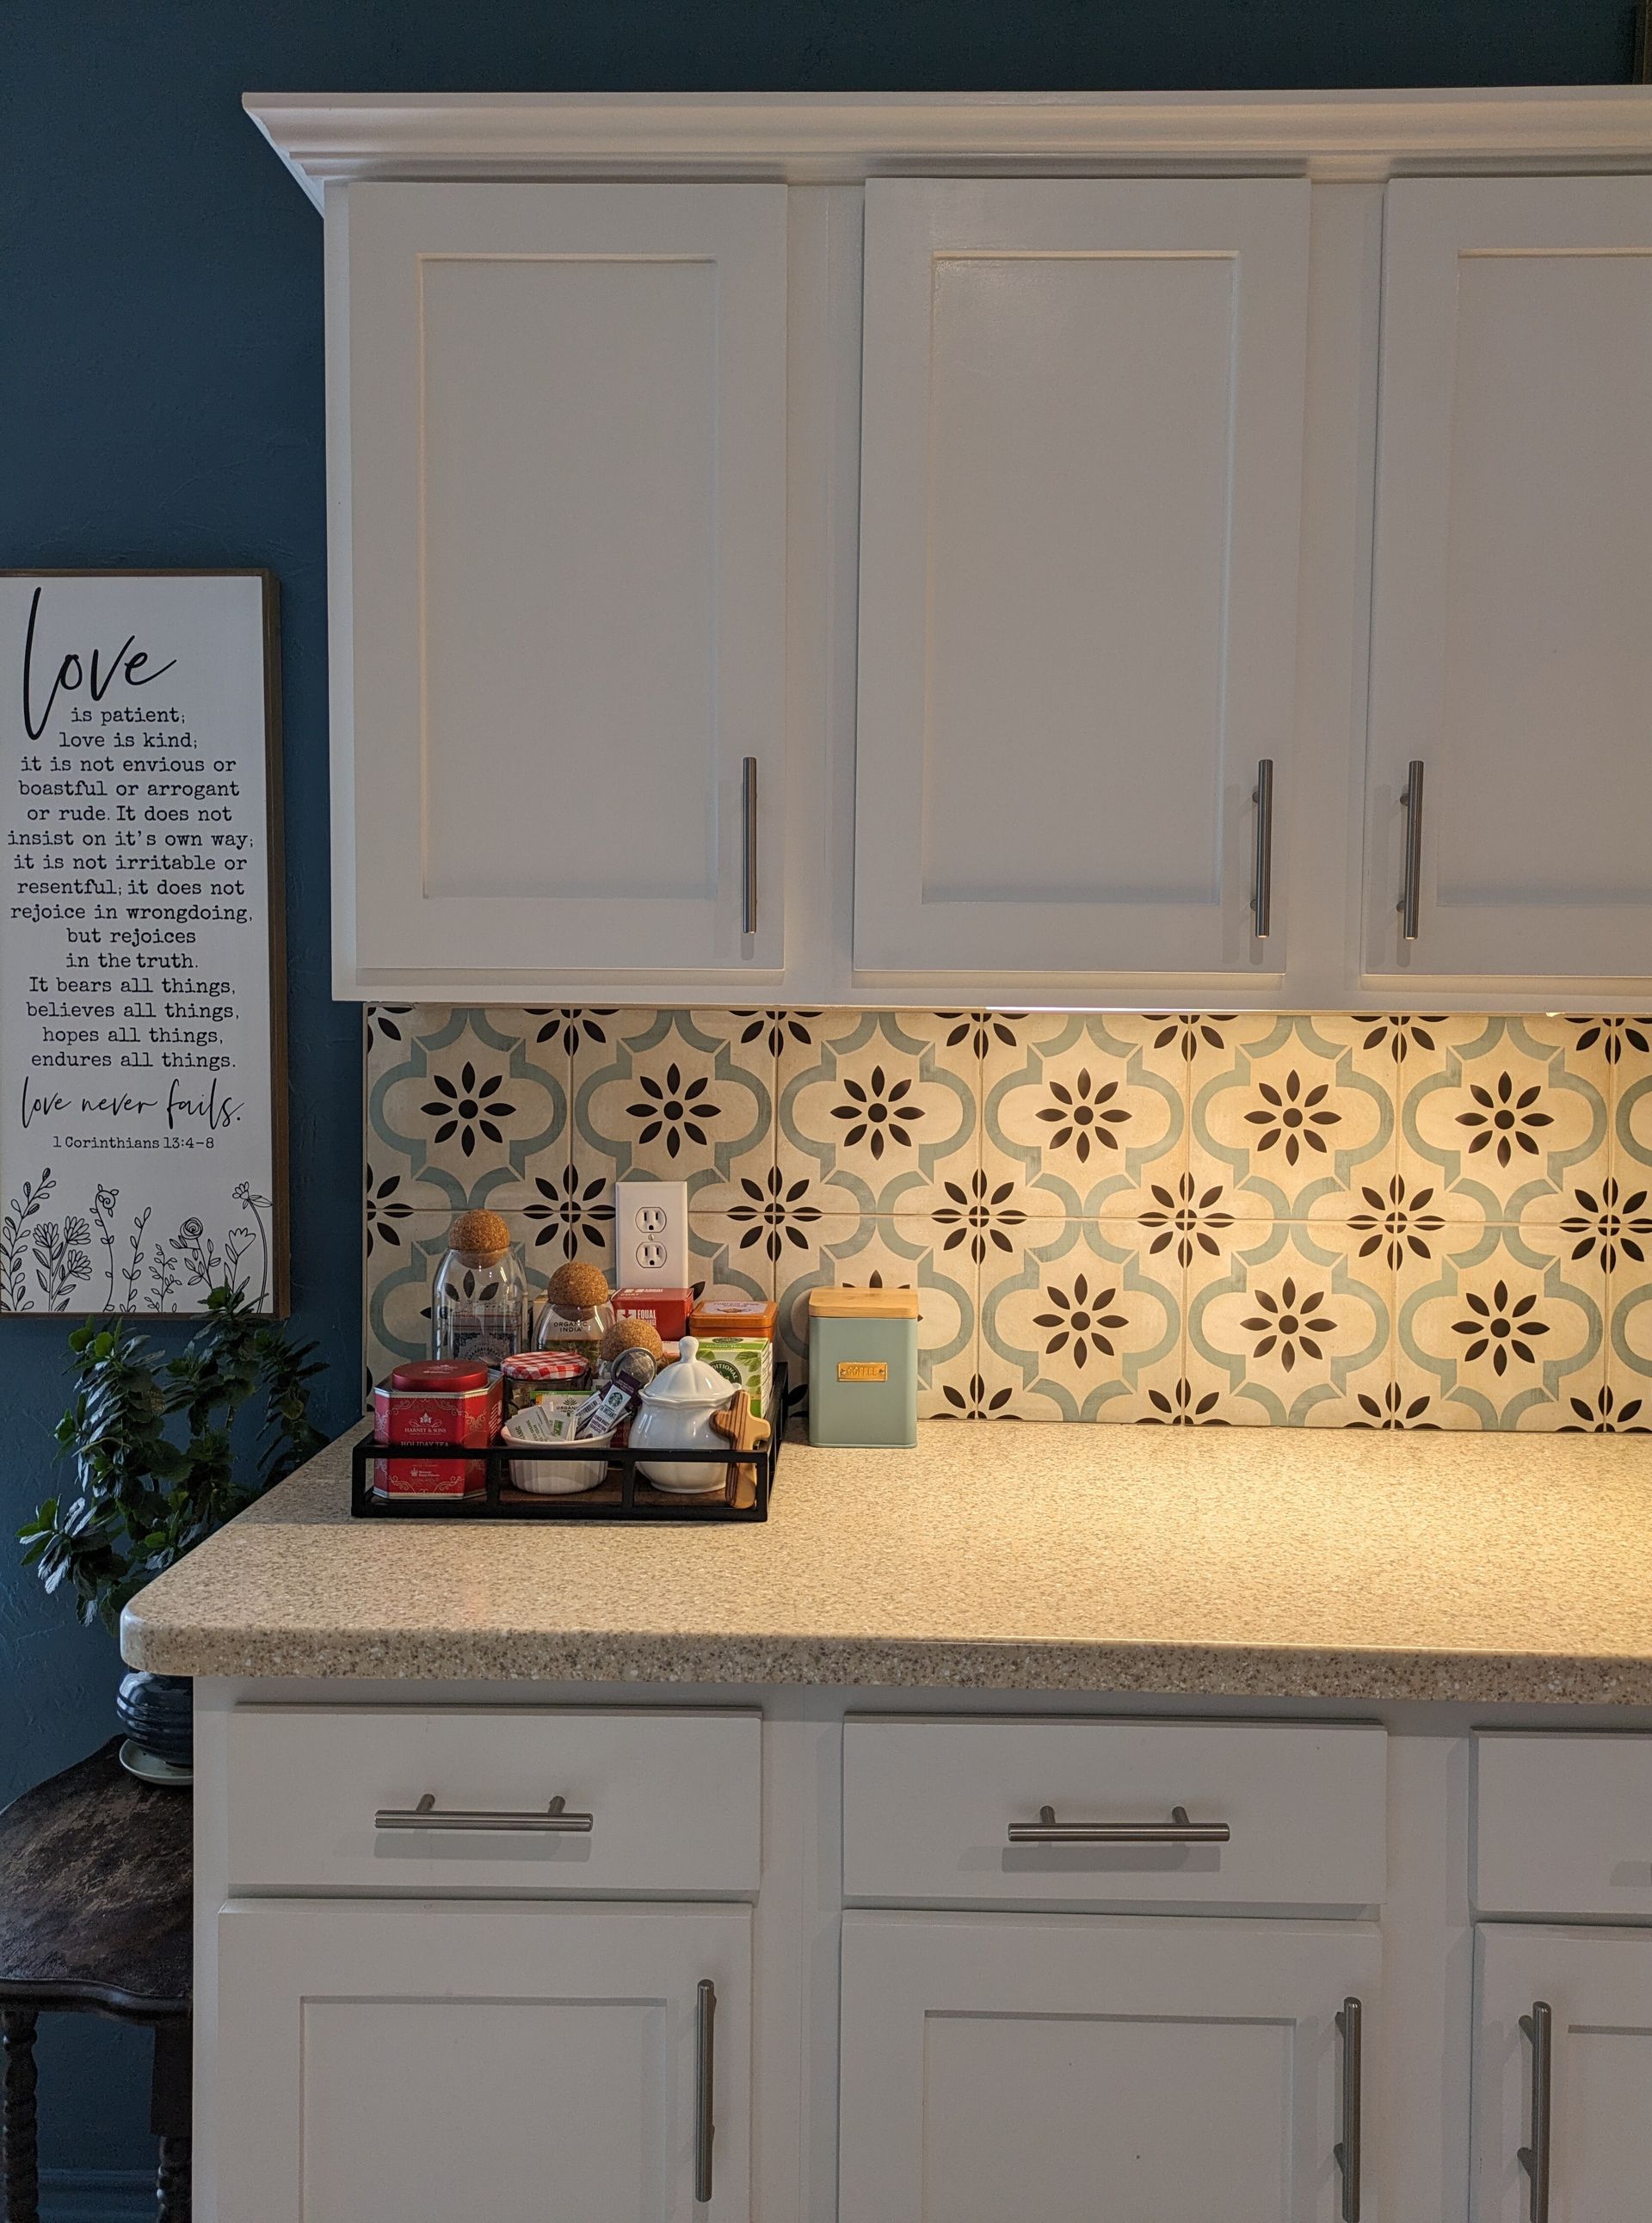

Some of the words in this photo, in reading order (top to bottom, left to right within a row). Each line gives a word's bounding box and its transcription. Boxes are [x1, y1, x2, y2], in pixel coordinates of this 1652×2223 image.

[71, 706, 93, 723] is
[100, 706, 185, 727] patient;
[59, 731, 105, 748] love
[113, 731, 135, 748] is
[142, 731, 197, 749] kind;
[21, 755, 42, 772] it
[50, 755, 71, 772] is
[79, 755, 114, 773] not
[122, 756, 205, 773] envious
[213, 760, 237, 773] or
[17, 779, 108, 797] boastful
[115, 784, 139, 797] or
[147, 780, 240, 801] arrogant
[27, 809, 51, 821] or
[58, 805, 110, 822] rude.
[116, 804, 136, 822] It
[144, 805, 189, 822] does
[197, 805, 232, 822] not
[7, 829, 74, 846] insist
[82, 834, 107, 847] on
[114, 830, 157, 847] it's
[164, 834, 203, 847] own
[210, 834, 253, 851] way;
[13, 853, 35, 870] it
[42, 853, 65, 870] is
[72, 853, 108, 870] not
[115, 854, 216, 871] irritable
[224, 859, 248, 871] or
[16, 878, 122, 896] resentful;
[127, 878, 149, 896] it
[157, 878, 202, 896] does
[210, 879, 245, 896] not
[9, 903, 86, 923] rejoice
[94, 903, 118, 920] in
[126, 904, 253, 924] wrongdoing,
[65, 927, 102, 944] but
[109, 927, 196, 948] rejoices
[65, 952, 90, 968] in
[97, 951, 132, 968] the
[135, 952, 199, 969] truth.
[28, 976, 49, 993] It
[55, 976, 112, 993] bears
[120, 977, 154, 994] all
[161, 977, 236, 998] things,
[25, 1001, 115, 1018] believes
[123, 1001, 157, 1018] all
[163, 1002, 239, 1023] things,
[42, 1026, 100, 1046] hopes
[108, 1026, 141, 1043] all
[148, 1026, 223, 1047] things,
[31, 1050, 112, 1067] endures
[120, 1051, 154, 1068] all
[161, 1051, 236, 1072] things.
[22, 1075, 72, 1129] love
[81, 1093, 158, 1117] never
[166, 1077, 245, 1130] fails.
[52, 1136, 62, 1148] 1
[65, 1136, 160, 1149] Corinthians
[637, 1309, 656, 1320] EQUAL
[713, 1363, 738, 1379] DITIONAL
